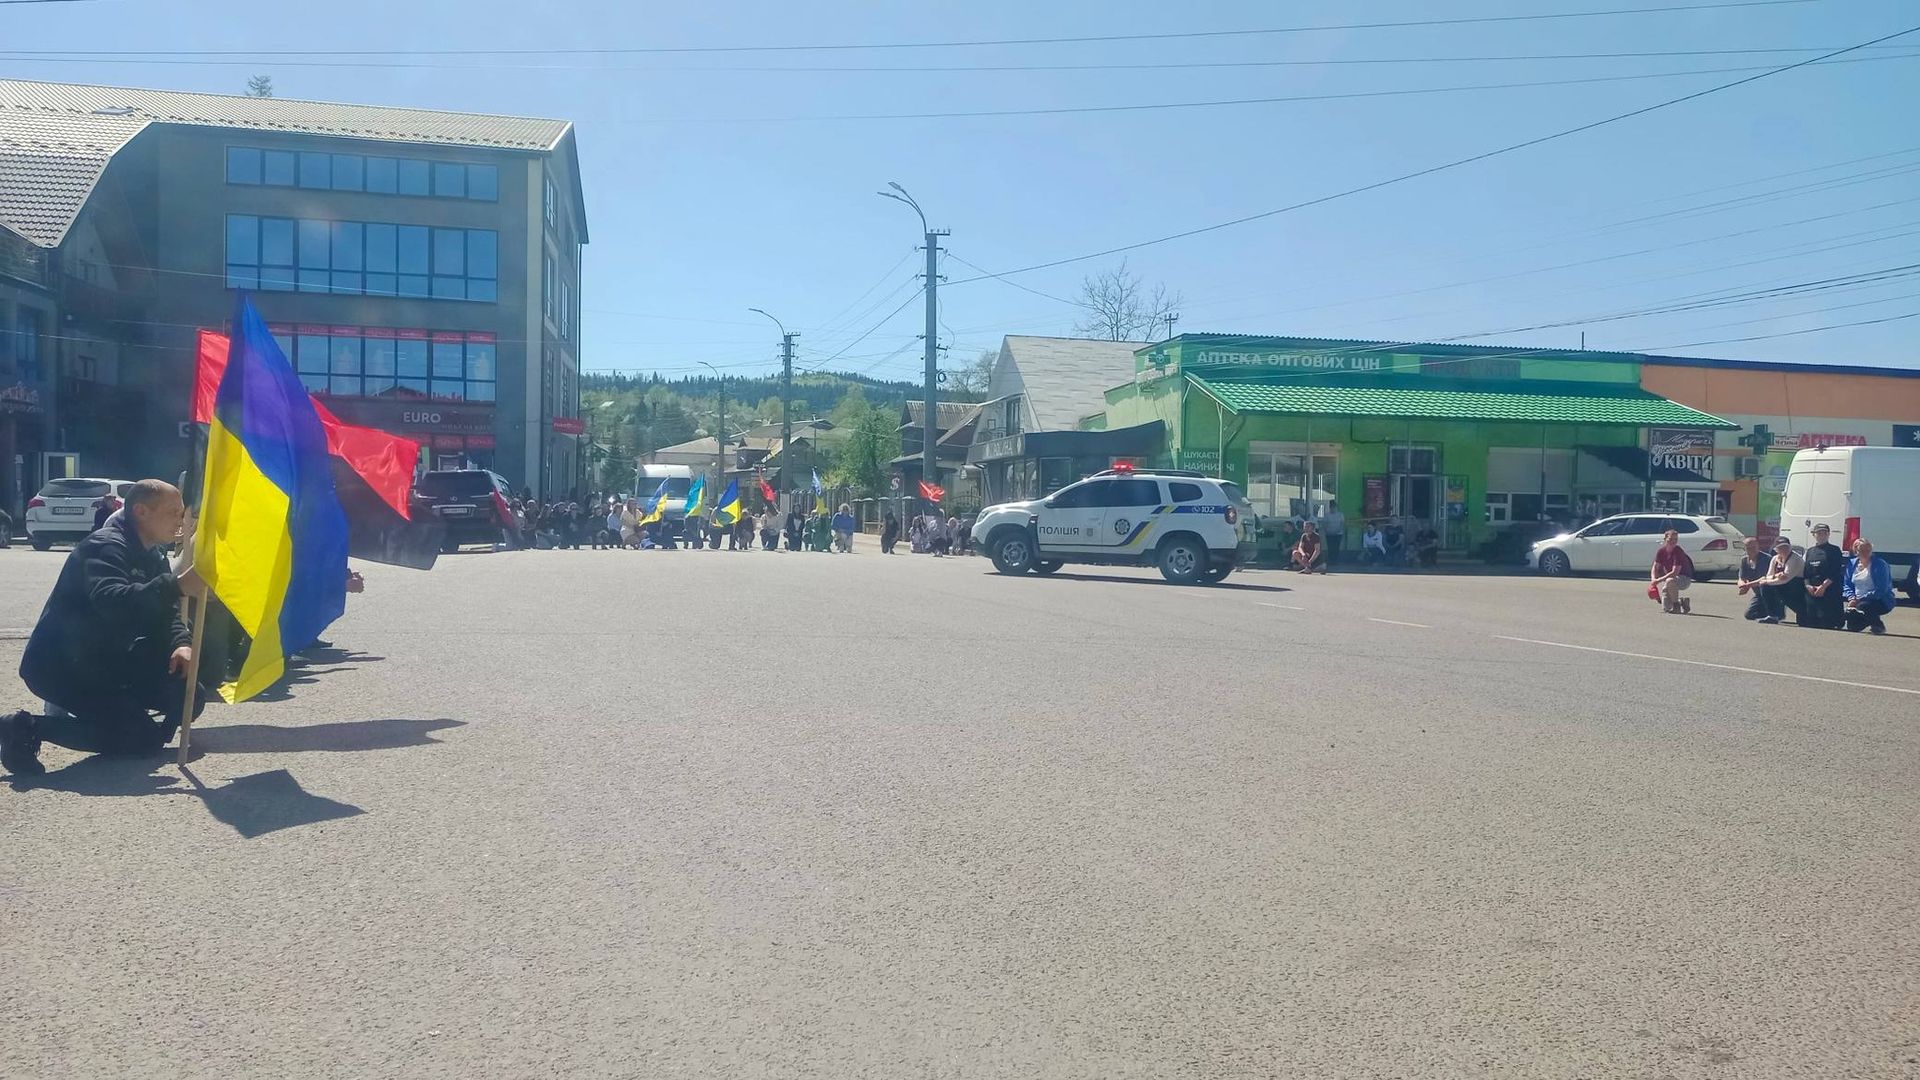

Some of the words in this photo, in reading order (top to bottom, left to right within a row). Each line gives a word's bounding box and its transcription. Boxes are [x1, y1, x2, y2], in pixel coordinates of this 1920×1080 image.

[1197, 352, 1262, 365] АПТЕКА
[1267, 354, 1345, 368] ОПТОВИХ
[1351, 357, 1380, 370] ЦІН
[403, 411, 441, 423] EURO
[1799, 434, 1867, 447] АПТЕКА
[1183, 461, 1235, 472] НАЙНИЧІ
[1664, 454, 1712, 470] КВІТИ
[1039, 526, 1079, 535] ПОЛІЦІЯ
